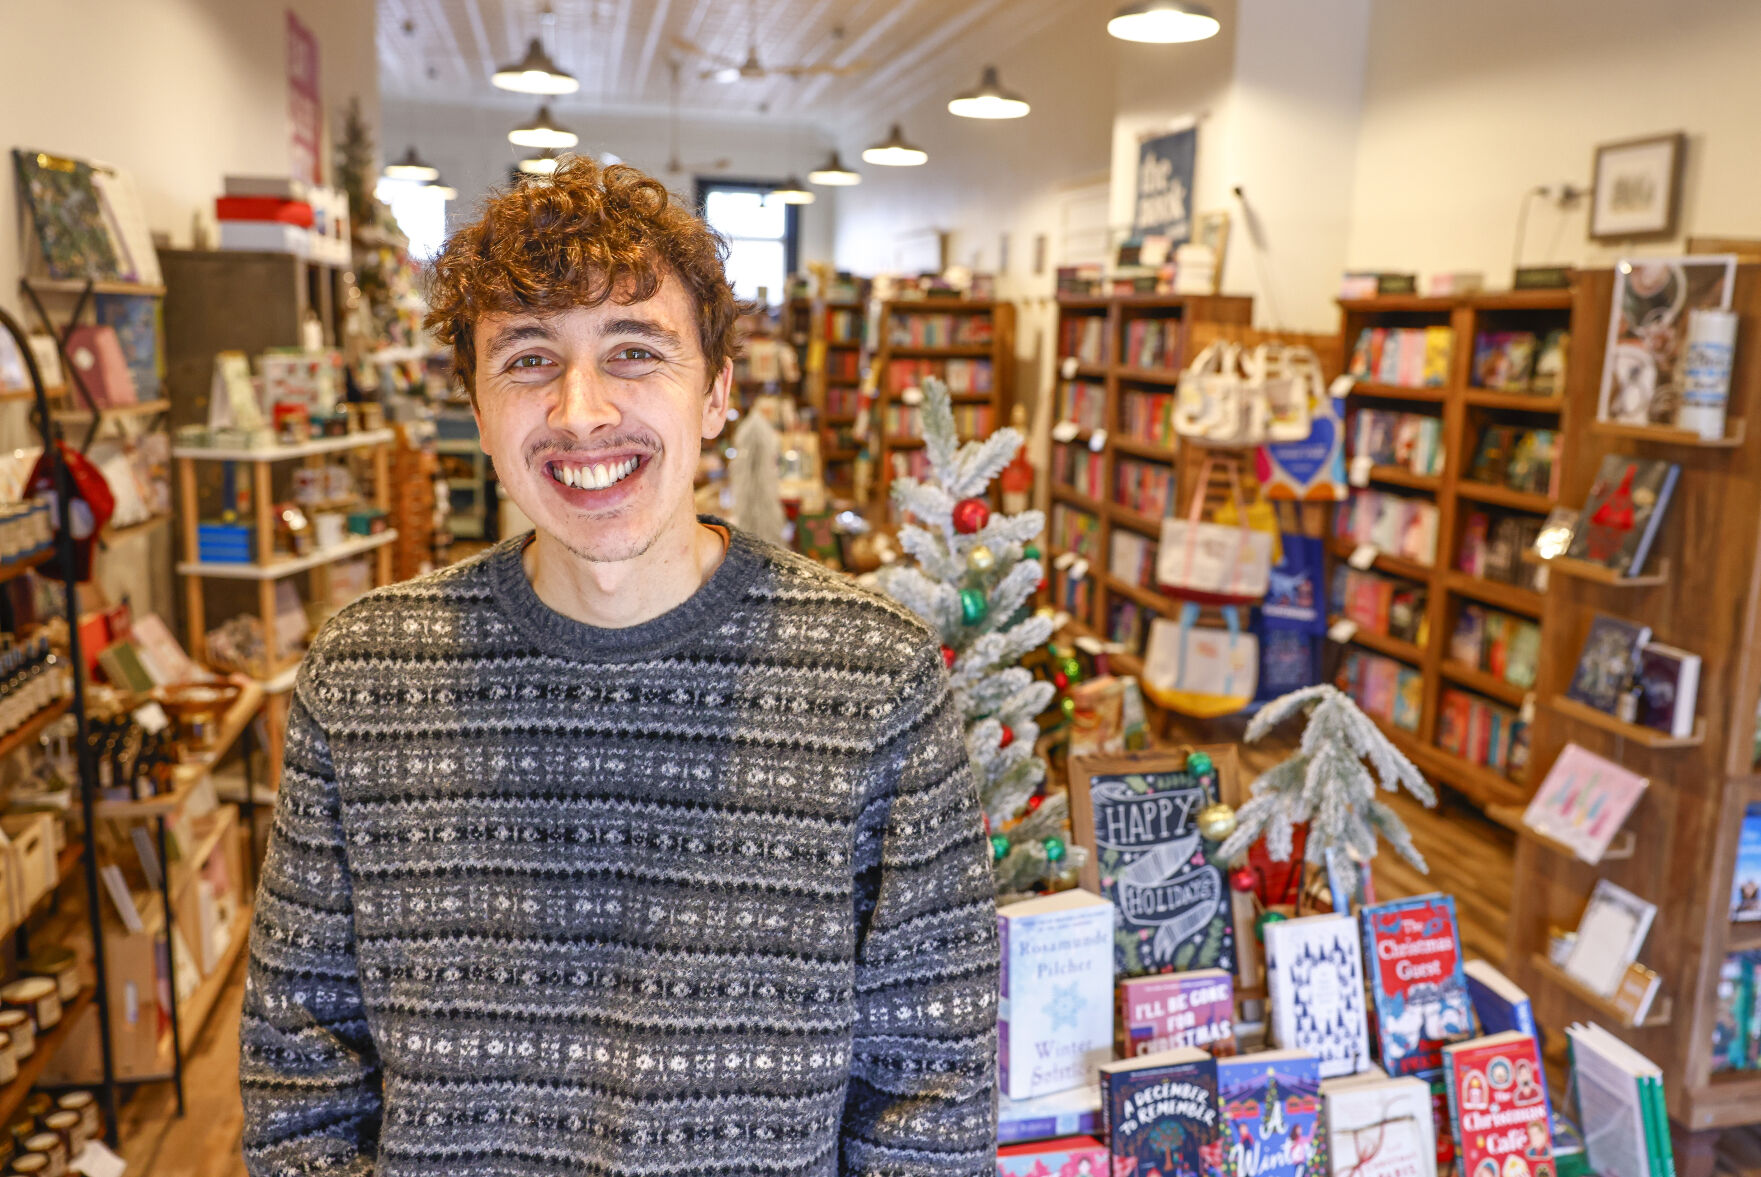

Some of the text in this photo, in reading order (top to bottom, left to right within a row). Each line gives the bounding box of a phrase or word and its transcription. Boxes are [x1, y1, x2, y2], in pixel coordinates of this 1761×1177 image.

[1105, 794, 1196, 844] HAPPY
[1126, 878, 1213, 915] HOLIDAYS
[1402, 918, 1424, 934] The
[1019, 931, 1109, 957] Rosamunde
[1378, 936, 1454, 960] Christmas
[1037, 956, 1093, 979] Pilcher
[1395, 959, 1442, 981] Guest
[1135, 1000, 1165, 1020] I'LL
[1167, 993, 1188, 1014] BE
[1189, 983, 1230, 1008] GONE
[1166, 1011, 1196, 1033] FOR
[1034, 1038, 1094, 1059] Winter
[1123, 1081, 1210, 1120] A DECEMBER
[1119, 1099, 1217, 1136] TO REMEMBER
[1259, 1100, 1288, 1141] A
[1462, 1104, 1547, 1133] Christmas
[1486, 1127, 1529, 1155] Café
